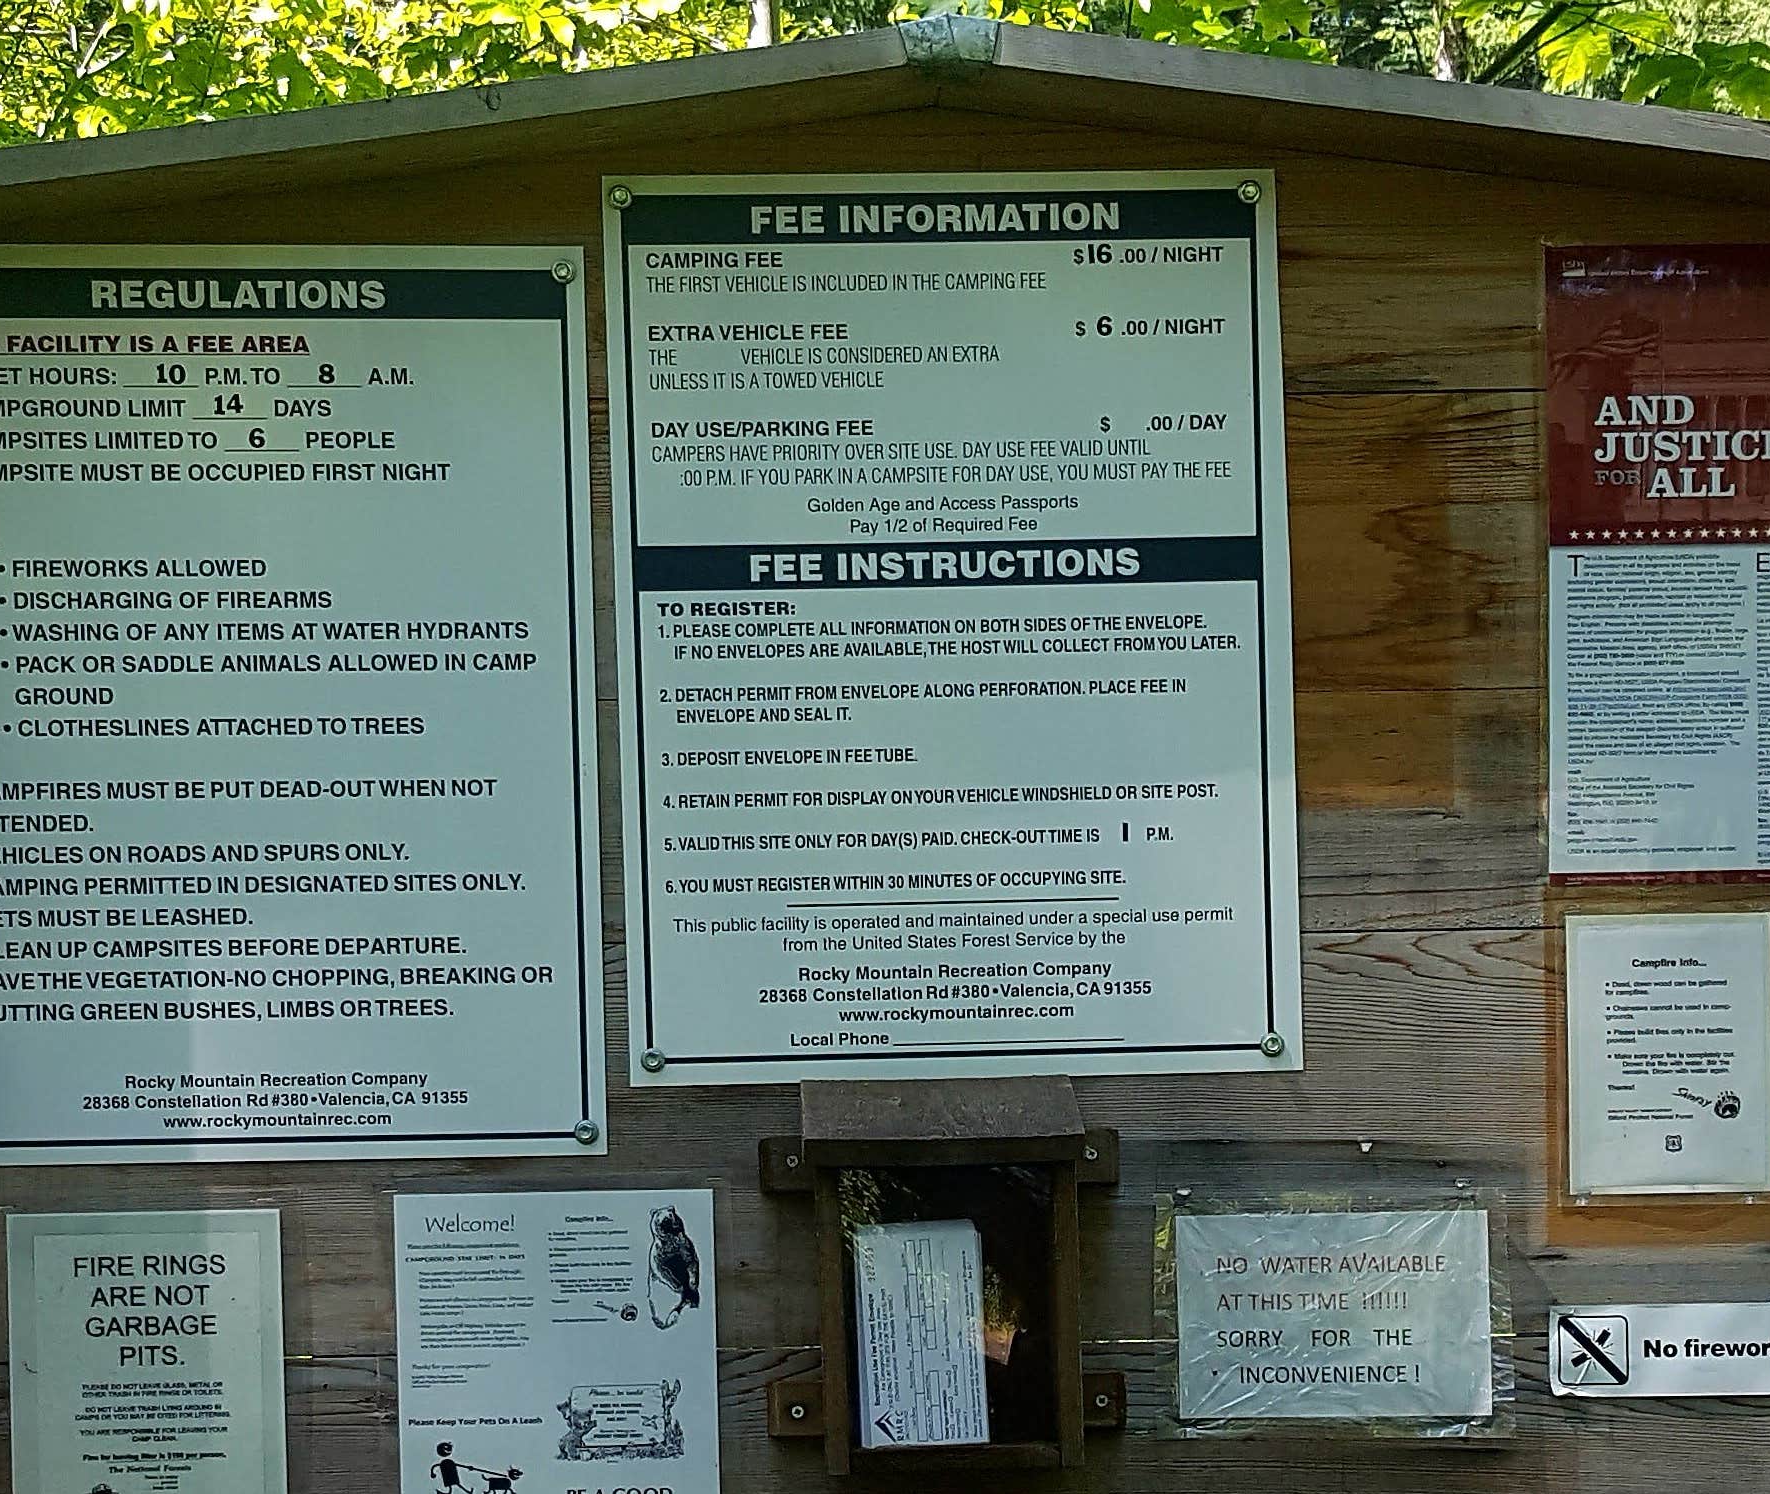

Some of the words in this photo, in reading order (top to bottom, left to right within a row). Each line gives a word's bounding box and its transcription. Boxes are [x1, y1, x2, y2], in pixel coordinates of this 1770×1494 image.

[751, 205, 825, 234] FEE
[839, 202, 1120, 233] INFORMATION
[645, 252, 739, 269] CAMPING
[745, 251, 784, 267] FEE
[1163, 246, 1224, 263] NIGHT
[645, 276, 675, 293] THE
[679, 276, 721, 293] FIRST
[724, 275, 788, 293] VEHICLE
[792, 275, 807, 292] IS
[811, 274, 888, 292] INCLUDED
[892, 274, 908, 291] IN
[911, 273, 941, 291] THE
[944, 273, 1016, 289] CAMPING
[1020, 271, 1047, 289] FEE
[91, 279, 386, 310] REGULATIONS
[648, 325, 715, 342] EXTRA
[718, 324, 805, 341] VEHICLE
[810, 323, 849, 339] FEE
[1075, 321, 1086, 337] $
[1096, 315, 1113, 336] 6
[1164, 318, 1226, 335] NIGHT
[7, 335, 122, 354] FACILITY
[129, 335, 154, 353] IS
[161, 336, 179, 353] A
[187, 335, 234, 353] FEE
[241, 335, 311, 354] AREA
[28, 366, 117, 385] HOURS:
[156, 363, 187, 384] 10
[205, 368, 248, 385] P.M.
[249, 368, 281, 385] TO
[318, 363, 335, 384] 8
[368, 367, 414, 384] A.M.
[128, 400, 187, 418] LIMIT
[213, 393, 244, 415] 14
[274, 400, 332, 418] DAYS
[1594, 395, 1695, 426] AND
[94, 432, 184, 450] LIMITED
[186, 432, 218, 450] TO
[248, 427, 266, 448] 6
[305, 432, 396, 449] PEOPLE
[651, 422, 690, 438] DAY
[695, 420, 830, 438] USE/PARKING
[836, 419, 874, 436] FEE
[80, 464, 144, 481] MUST
[150, 464, 182, 481] BE
[187, 464, 305, 481] OCCUPIED
[312, 464, 376, 481] FIRST
[382, 464, 451, 481] NIGHT
[1646, 467, 1737, 498] ALL
[807, 497, 864, 512] Golden
[868, 497, 901, 516] Age
[905, 496, 935, 511] and
[939, 496, 996, 511] Access
[1001, 494, 1079, 513] Passports
[850, 518, 879, 536] Pay
[884, 518, 908, 533] 1/2
[912, 517, 927, 532] of
[932, 516, 1004, 535] Required
[1008, 516, 1038, 531] Fee
[12, 559, 149, 578] FIREWORKS
[155, 559, 267, 577] ALLOWED
[749, 553, 823, 582] FEE
[837, 547, 1140, 581] INSTRUCTIONS
[13, 592, 172, 610] DISCHARGING
[178, 592, 210, 609] OF
[216, 590, 332, 609] FIREARMS
[656, 602, 684, 617] TO
[690, 601, 796, 617] REGISTER:
[37, 909, 101, 927] MUST
[106, 909, 137, 926] BE
[142, 908, 254, 926] LEASHED.
[798, 966, 851, 985] Rocky
[855, 964, 933, 980] Mountain
[938, 962, 1028, 978] Recreation
[1032, 961, 1112, 979] Company
[1631, 959, 1677, 969] Campfire
[838, 1003, 1074, 1025] www.rockymountainrec.com
[790, 1033, 834, 1047] Local
[838, 1032, 889, 1045] Phone
[124, 1075, 176, 1092] Rocky
[180, 1073, 255, 1088] Mountain
[260, 1072, 347, 1086] Recreation
[351, 1072, 428, 1088] Company
[162, 1111, 392, 1131] www.rockymountainrec.com
[425, 1213, 515, 1232] Welcome!
[73, 1256, 135, 1278] FIRE
[143, 1254, 226, 1277] RINGS
[1216, 1257, 1248, 1275] NO
[1260, 1256, 1332, 1274] WATER
[1338, 1252, 1445, 1273] AVAILABLE
[90, 1286, 147, 1307] ARE
[155, 1284, 210, 1306] NOT
[1216, 1293, 1245, 1312] AT
[1249, 1293, 1293, 1312] THIS
[1297, 1293, 1349, 1310] TIME
[85, 1314, 218, 1338] GARBAGE
[1216, 1330, 1284, 1348] SORRY
[1311, 1329, 1351, 1348] FOR
[1372, 1329, 1412, 1346] THE
[119, 1345, 185, 1367] PITS.
[1643, 1340, 1678, 1358] No
[1239, 1365, 1408, 1385] INCONVENIENCE
[1415, 1365, 1420, 1383] !
